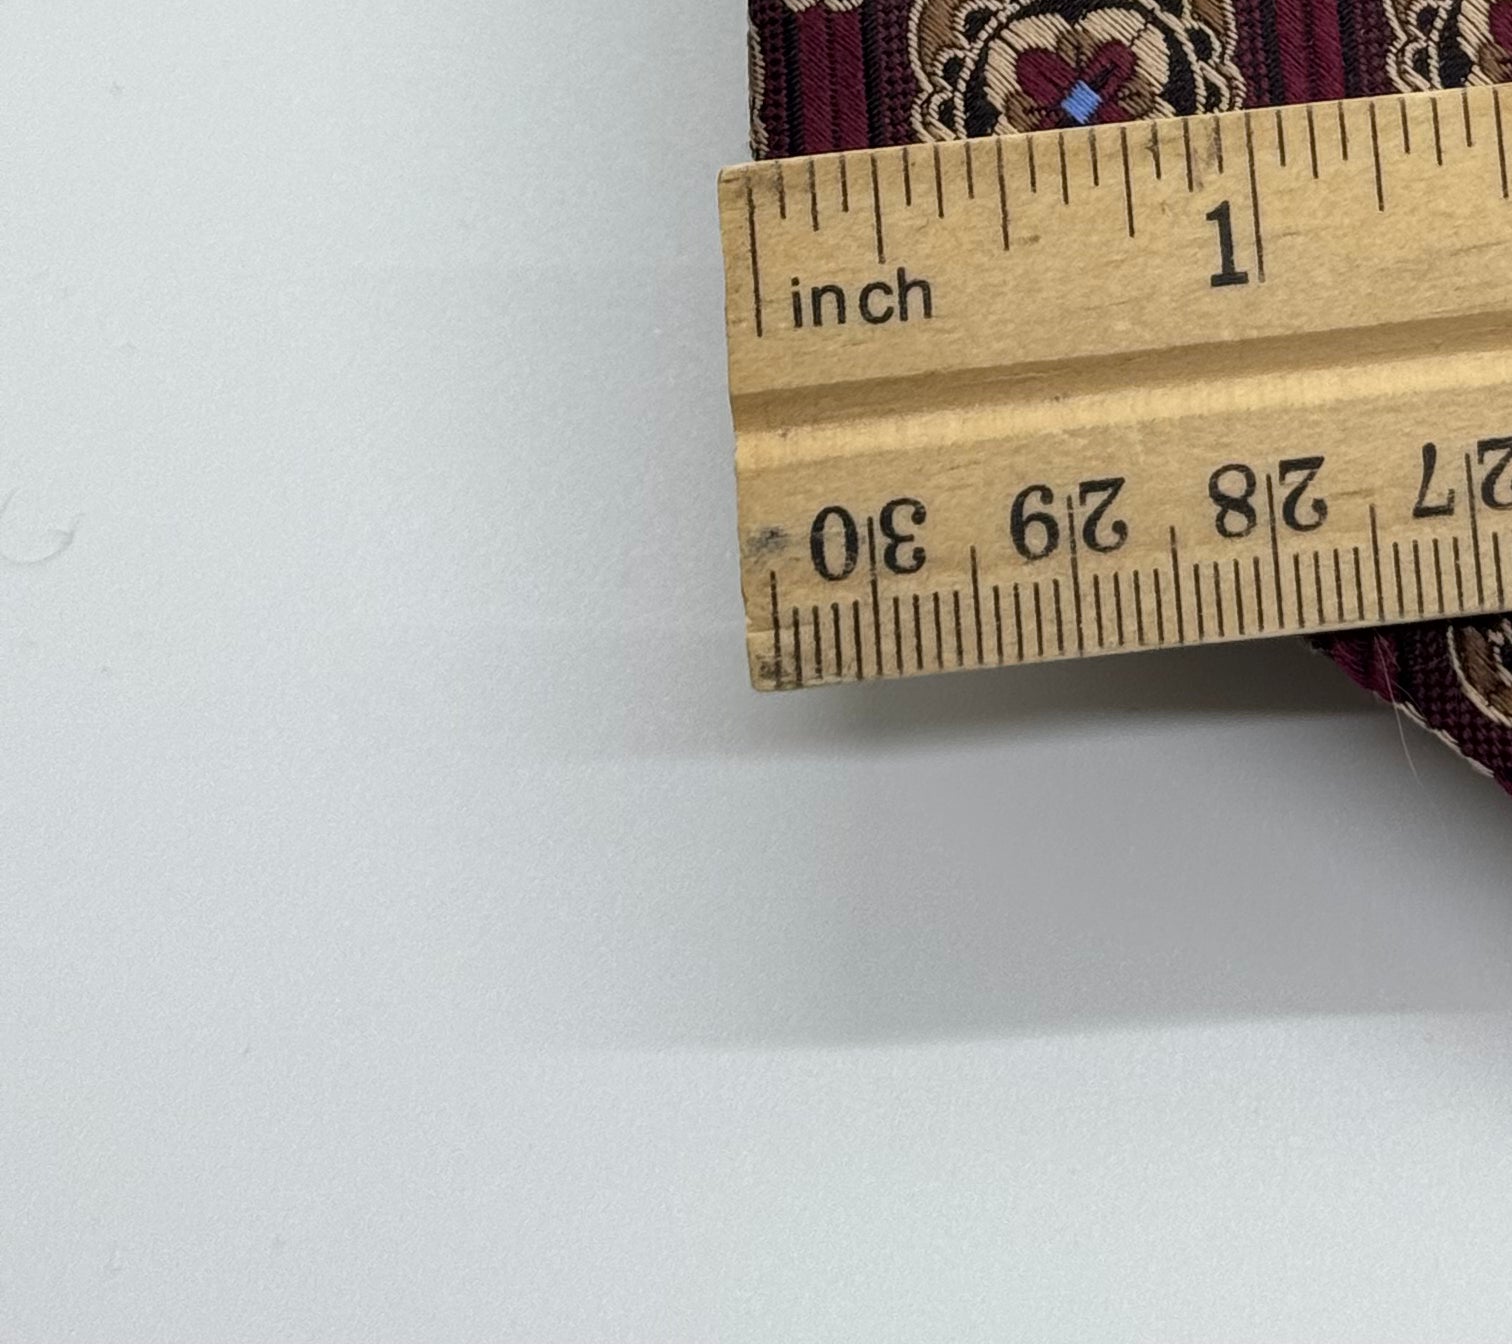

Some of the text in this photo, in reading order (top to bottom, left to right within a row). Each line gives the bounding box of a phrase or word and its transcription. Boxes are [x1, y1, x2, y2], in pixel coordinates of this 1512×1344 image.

[1204, 199, 1250, 288] 1
[788, 265, 934, 330] inch
[808, 497, 928, 583] 30
[1008, 476, 1130, 562] 29
[1206, 455, 1329, 539] 28
